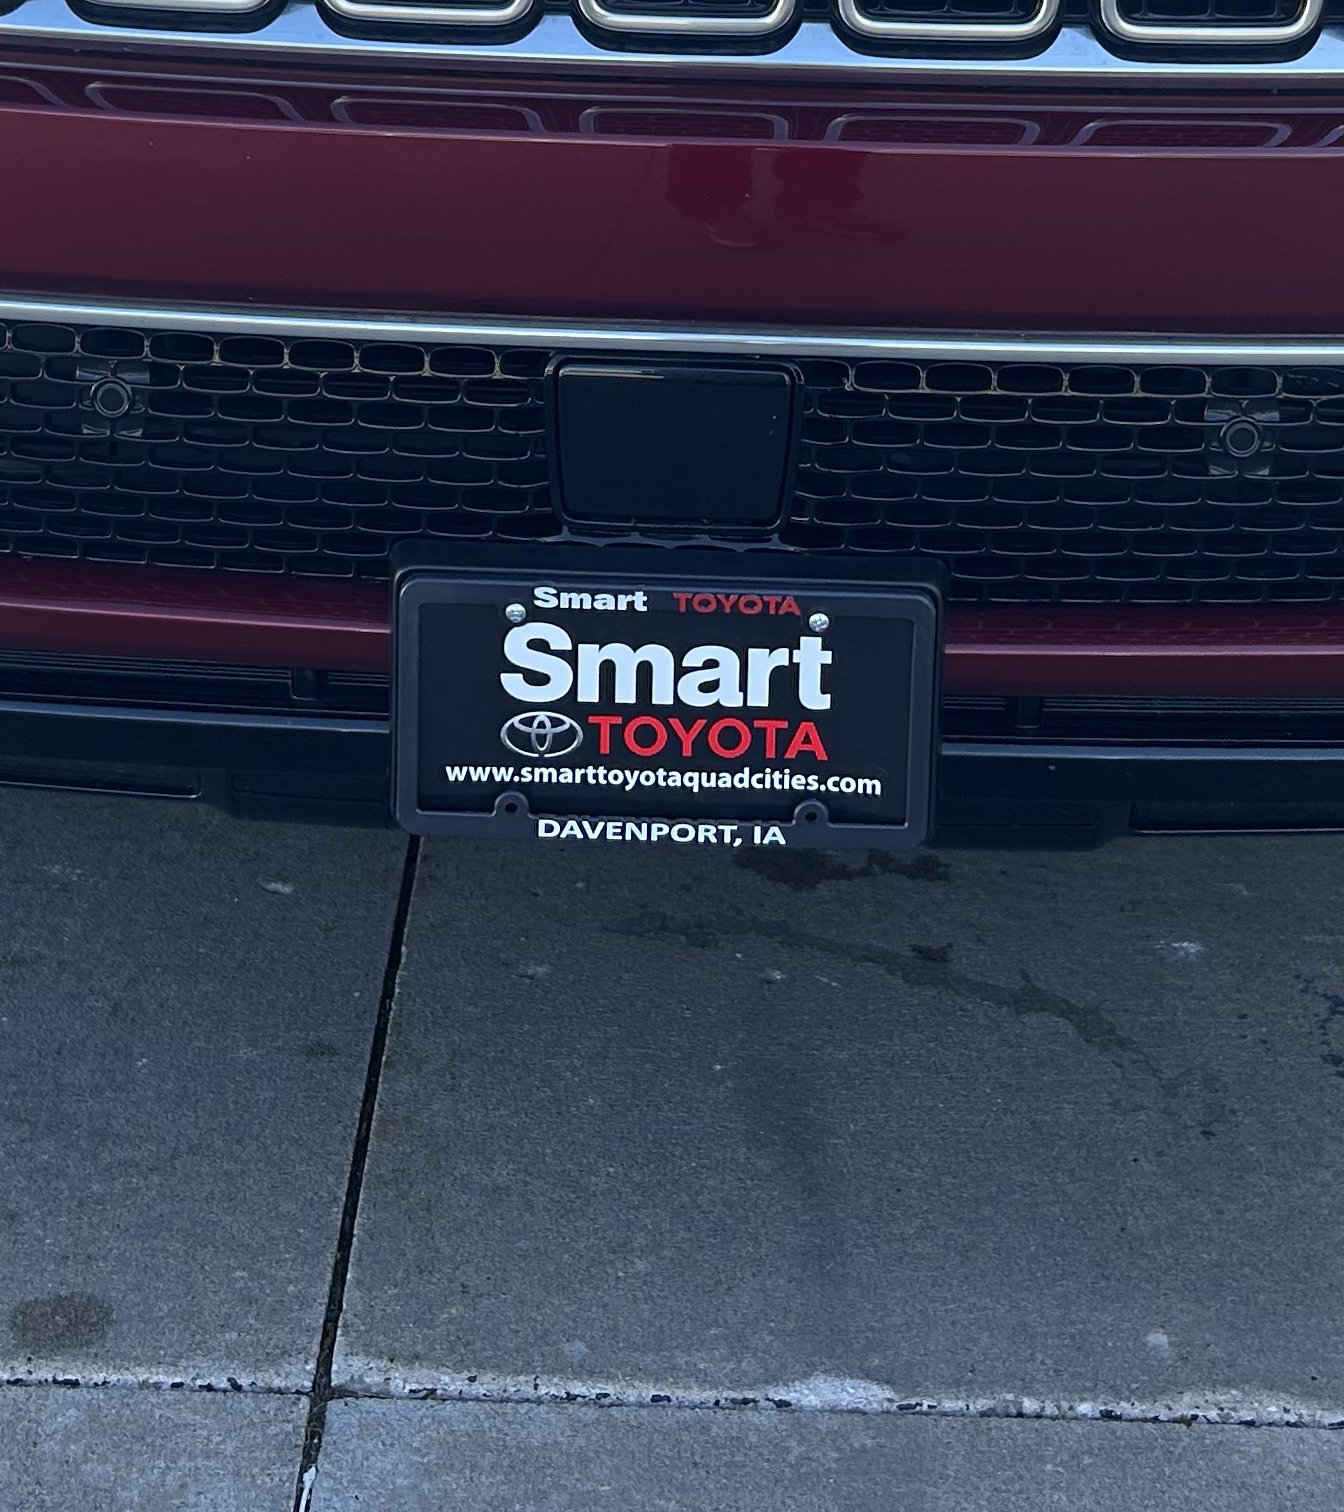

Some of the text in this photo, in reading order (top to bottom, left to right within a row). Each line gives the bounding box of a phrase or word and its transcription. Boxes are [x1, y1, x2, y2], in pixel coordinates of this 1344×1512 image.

[533, 585, 802, 616] Smart TOYOTA
[499, 621, 833, 711] Smart
[587, 715, 829, 761] TOYOTA
[445, 764, 882, 796] www.smarttoyotaquadcities.com
[537, 818, 787, 847] DAVENPORT, IA
